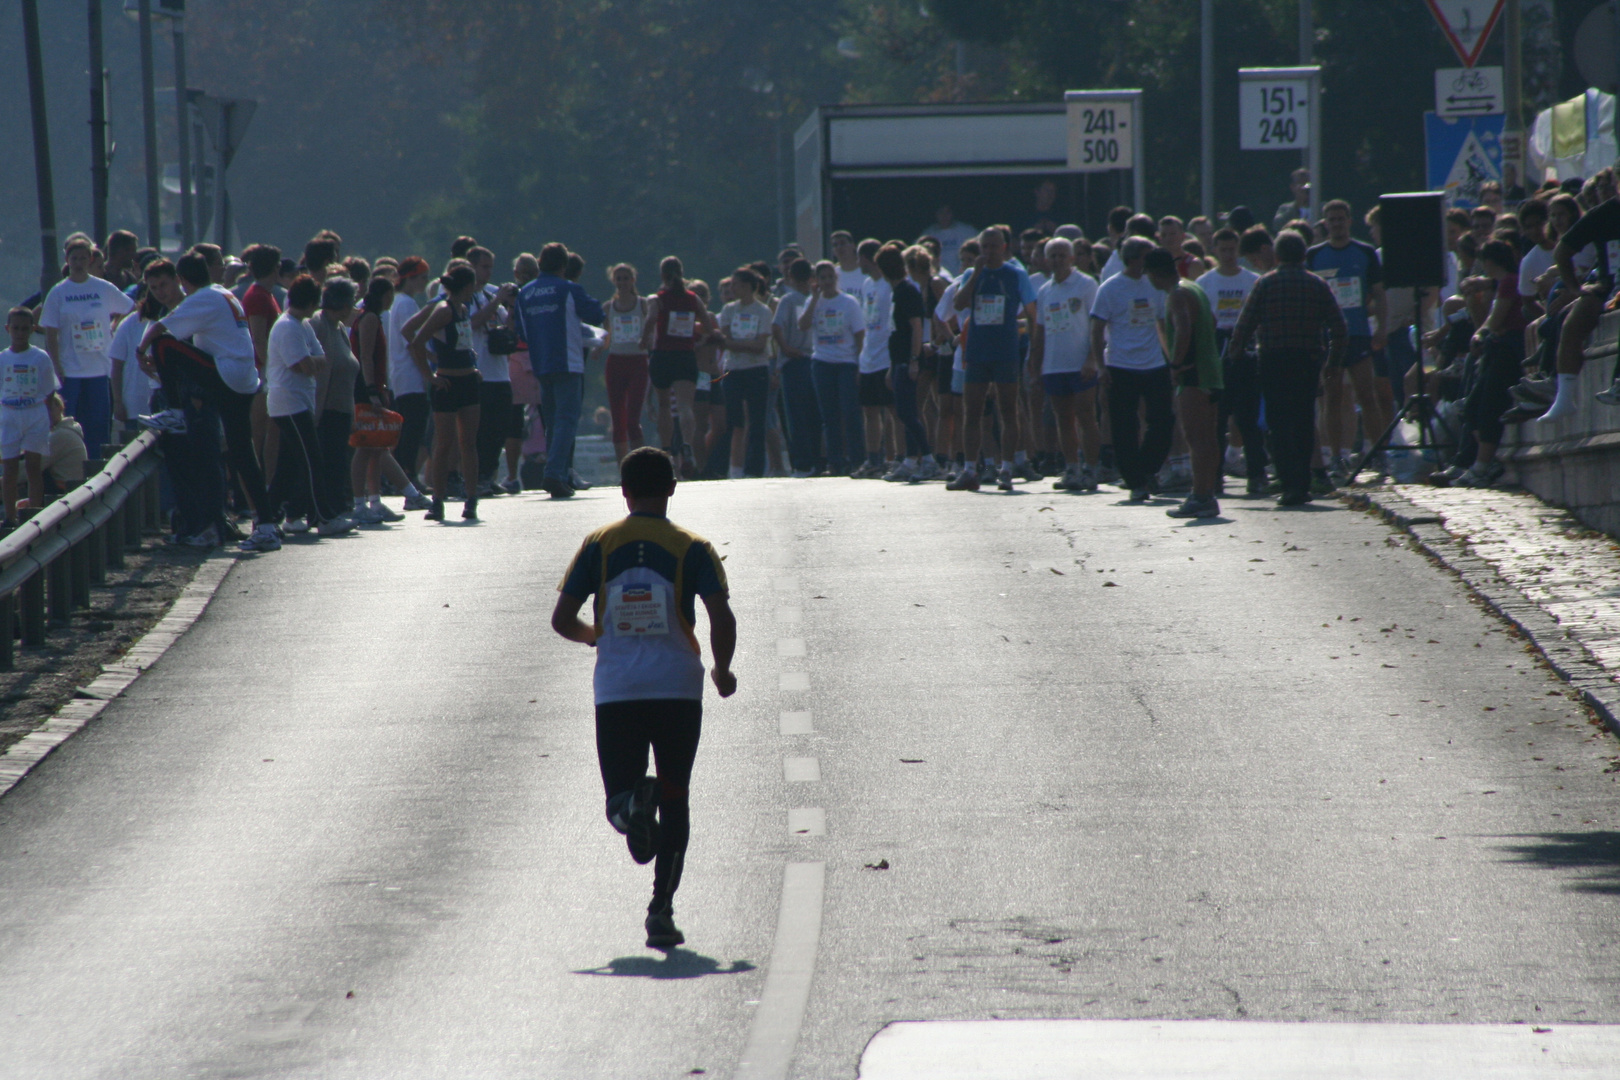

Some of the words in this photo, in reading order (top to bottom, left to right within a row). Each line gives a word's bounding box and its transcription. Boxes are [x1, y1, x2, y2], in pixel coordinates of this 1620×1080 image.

[1260, 87, 1307, 114] 151-
[1083, 109, 1127, 134] 241-
[1259, 118, 1298, 144] 240
[1083, 139, 1118, 163] 500
[65, 292, 100, 302] MANKA
